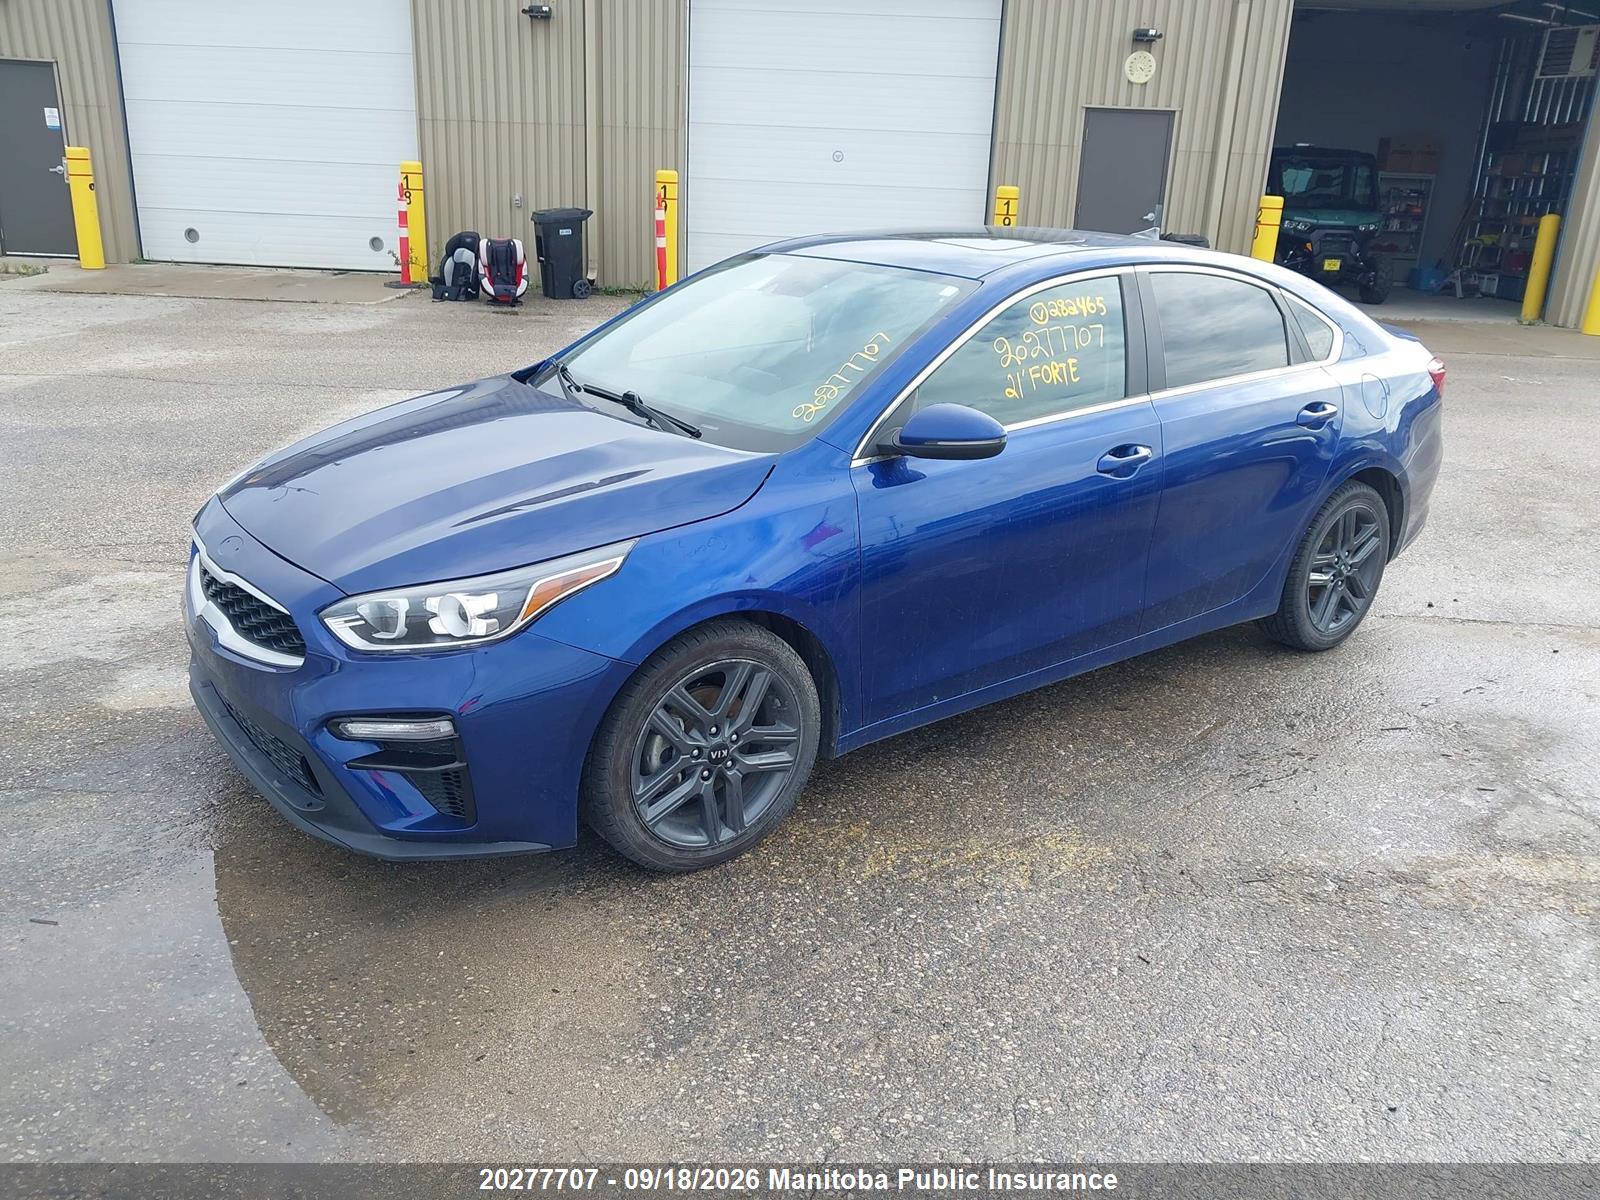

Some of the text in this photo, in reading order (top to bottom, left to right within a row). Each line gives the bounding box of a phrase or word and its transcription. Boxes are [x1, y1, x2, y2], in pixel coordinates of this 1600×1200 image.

[993, 323, 1104, 368] 20277707
[792, 332, 891, 422] 20277707
[1028, 358, 1080, 391] FORTE
[711, 749, 728, 759] KIA
